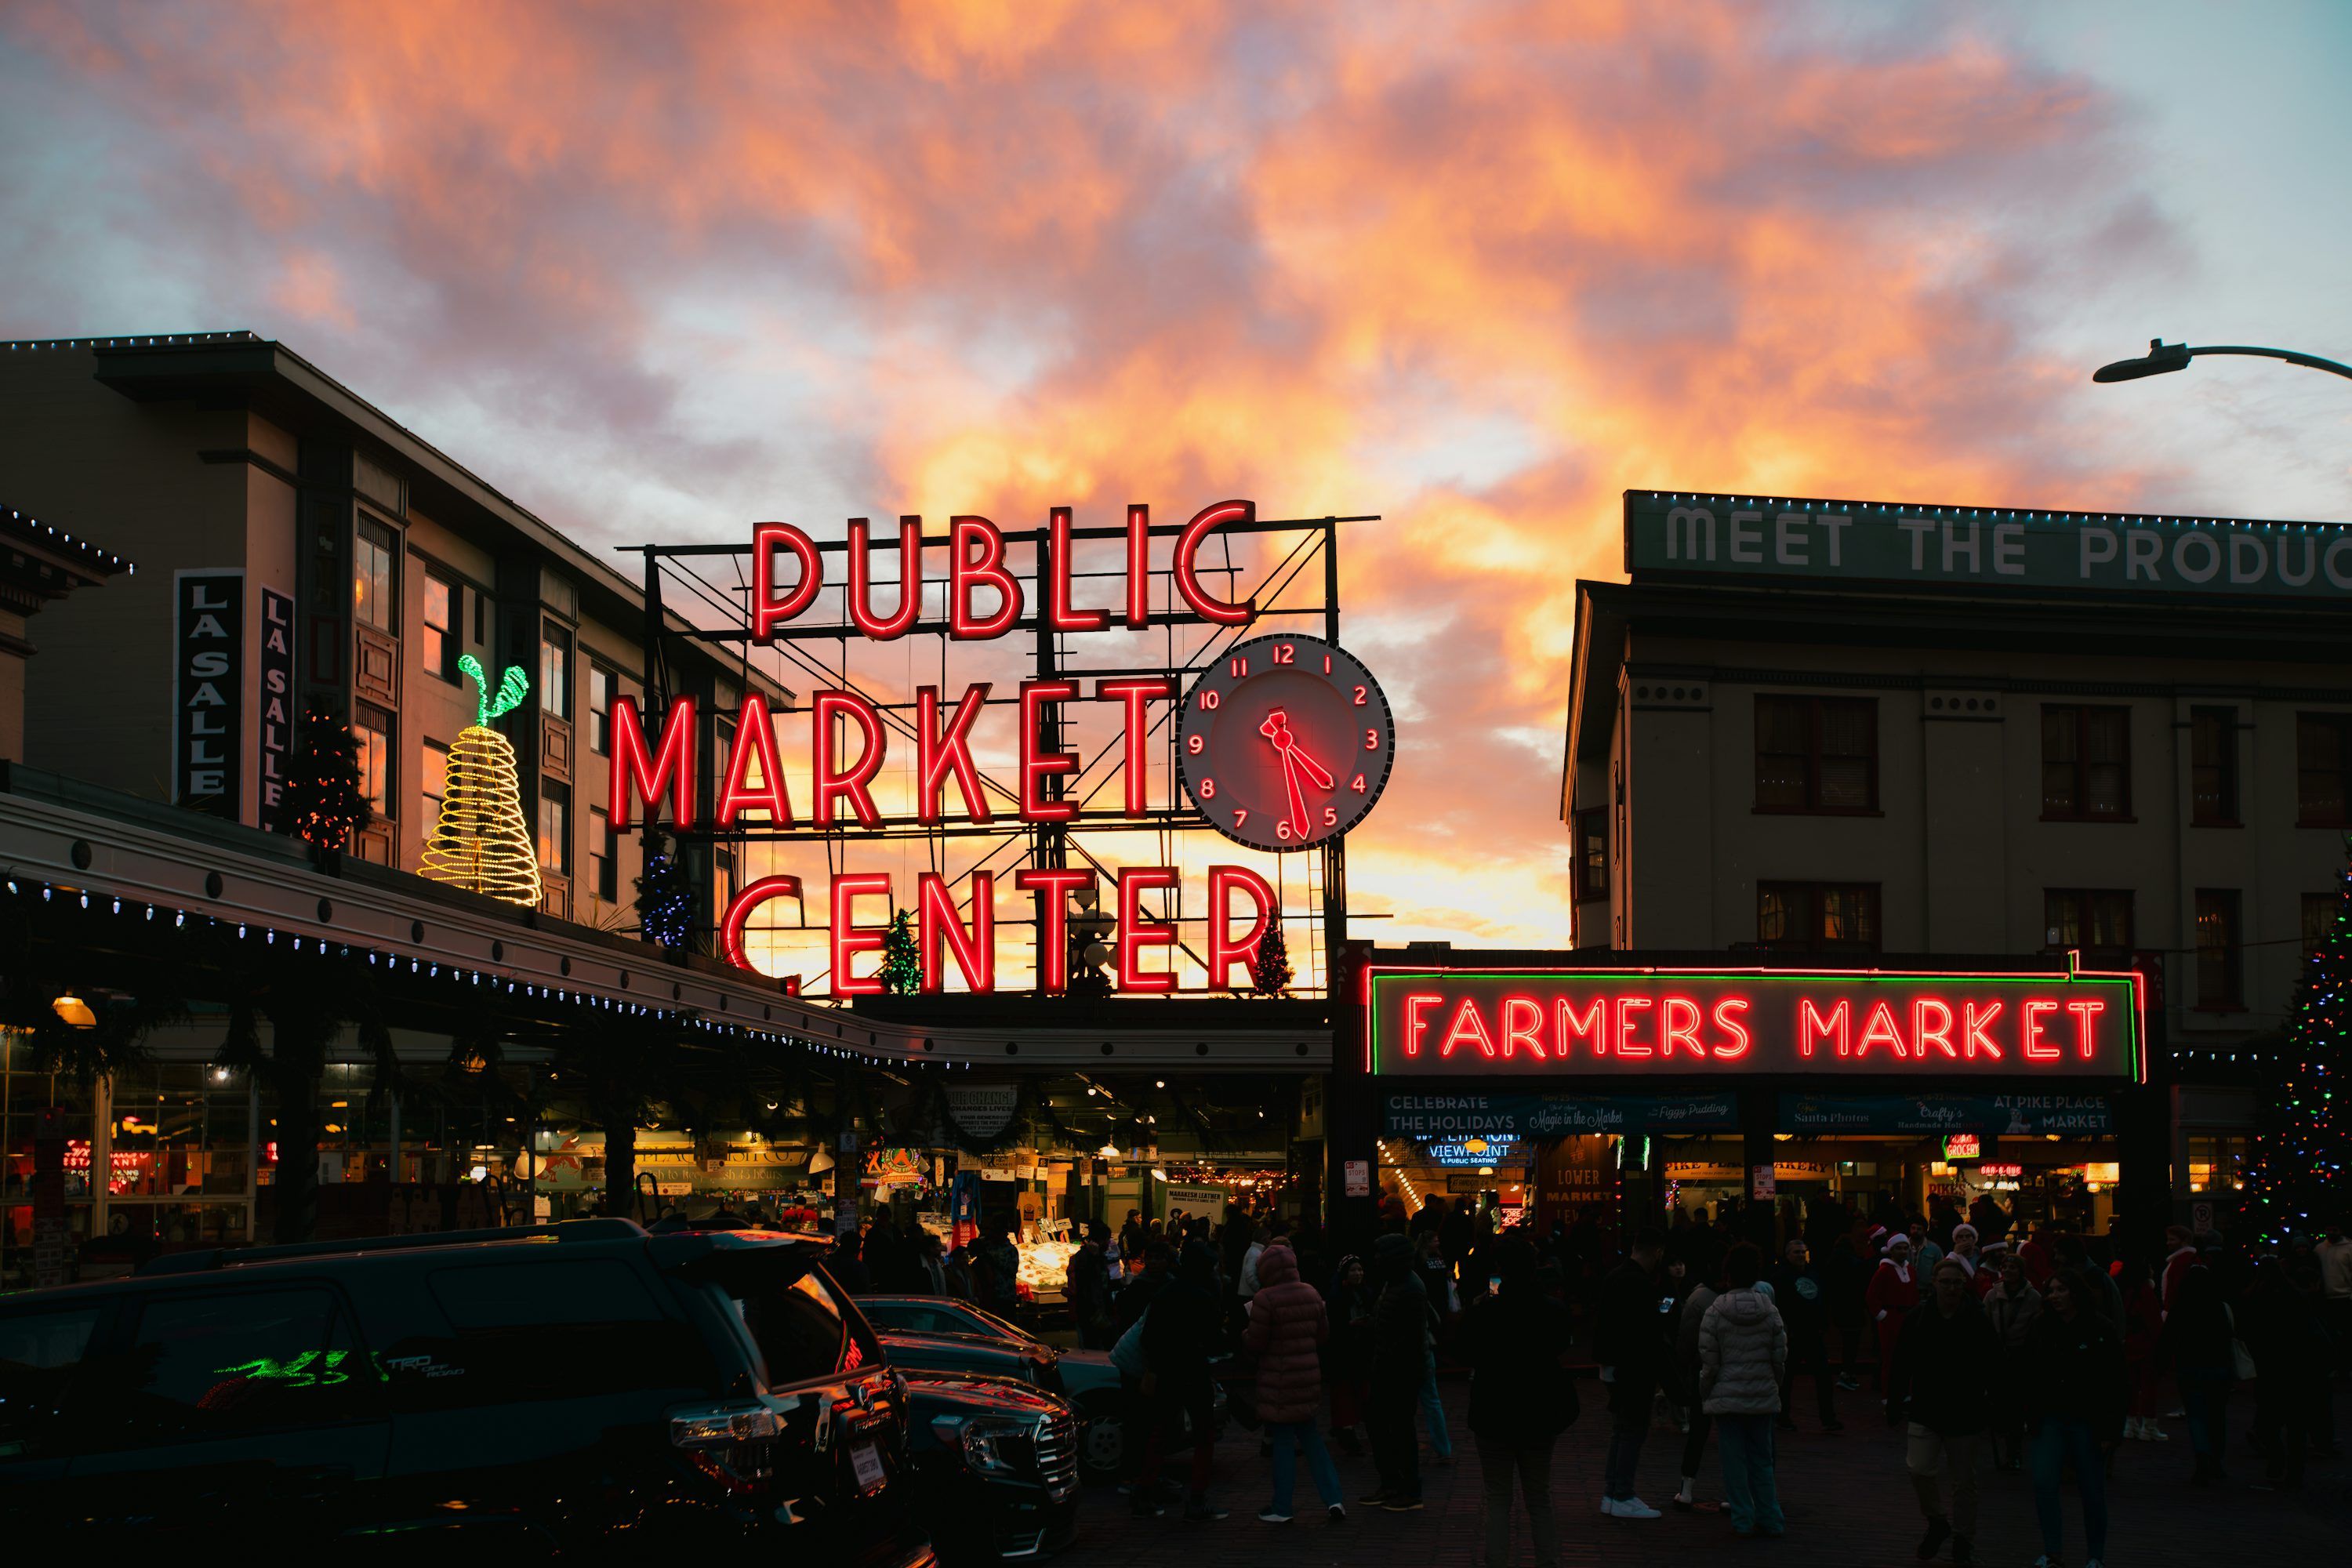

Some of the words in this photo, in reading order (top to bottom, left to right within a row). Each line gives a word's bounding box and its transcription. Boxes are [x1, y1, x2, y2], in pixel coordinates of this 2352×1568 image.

[1666, 506, 1853, 568] MEET
[1897, 518, 2026, 576] THE
[753, 499, 1256, 647] PUBLIC
[1273, 644, 1295, 665] 12
[1231, 658, 1248, 678] 11
[1323, 655, 1332, 675] 1
[1200, 690, 1220, 710] 10
[1353, 684, 1367, 706] 2
[1188, 735, 1204, 755] 9
[1366, 728, 1379, 750] 3
[609, 677, 1177, 834] MARKET
[1200, 778, 1216, 799] 8
[1351, 773, 1367, 794] 4
[1232, 809, 1248, 828] 7
[1323, 808, 1338, 826] 5
[1276, 820, 1291, 840] 6
[720, 865, 1283, 999] CENTER
[1403, 994, 1753, 1059] FARMERS
[1798, 998, 2107, 1060] MARKET
[969, 1091, 1018, 1105] CHANGE
[1389, 1096, 1490, 1109] CELEBRATE
[1994, 1096, 2013, 1109] AT
[2017, 1096, 2052, 1109] PIKE
[2056, 1096, 2106, 1109] PLACE
[1530, 1110, 1563, 1131] Magic
[1563, 1111, 1573, 1124] in
[1573, 1110, 1587, 1125] the
[1587, 1107, 1624, 1131] Market
[1659, 1105, 1686, 1120] Figgy
[1687, 1102, 1730, 1116] Pudding
[1794, 1112, 1829, 1123] Santa
[1830, 1112, 1869, 1123] Photos
[1920, 1105, 1965, 1123] Crafty's
[1390, 1116, 1425, 1130] THE
[1429, 1116, 1515, 1130] HOLIDAYS
[1897, 1121, 1941, 1130] Handmade
[2042, 1115, 2107, 1129] MARKET
[1947, 1143, 1980, 1156] GROCERY
[1665, 1161, 1700, 1172] PIKE
[1774, 1161, 1828, 1174] AKERY
[1557, 1170, 1600, 1185] LOWER
[1169, 1190, 1198, 1199] MARAKESH
[1199, 1192, 1221, 1200] LEATHER
[1546, 1192, 1613, 1202] MARKET
[386, 1355, 432, 1372] TRD
[421, 1363, 450, 1373] OFF
[426, 1367, 465, 1378] ROAD
